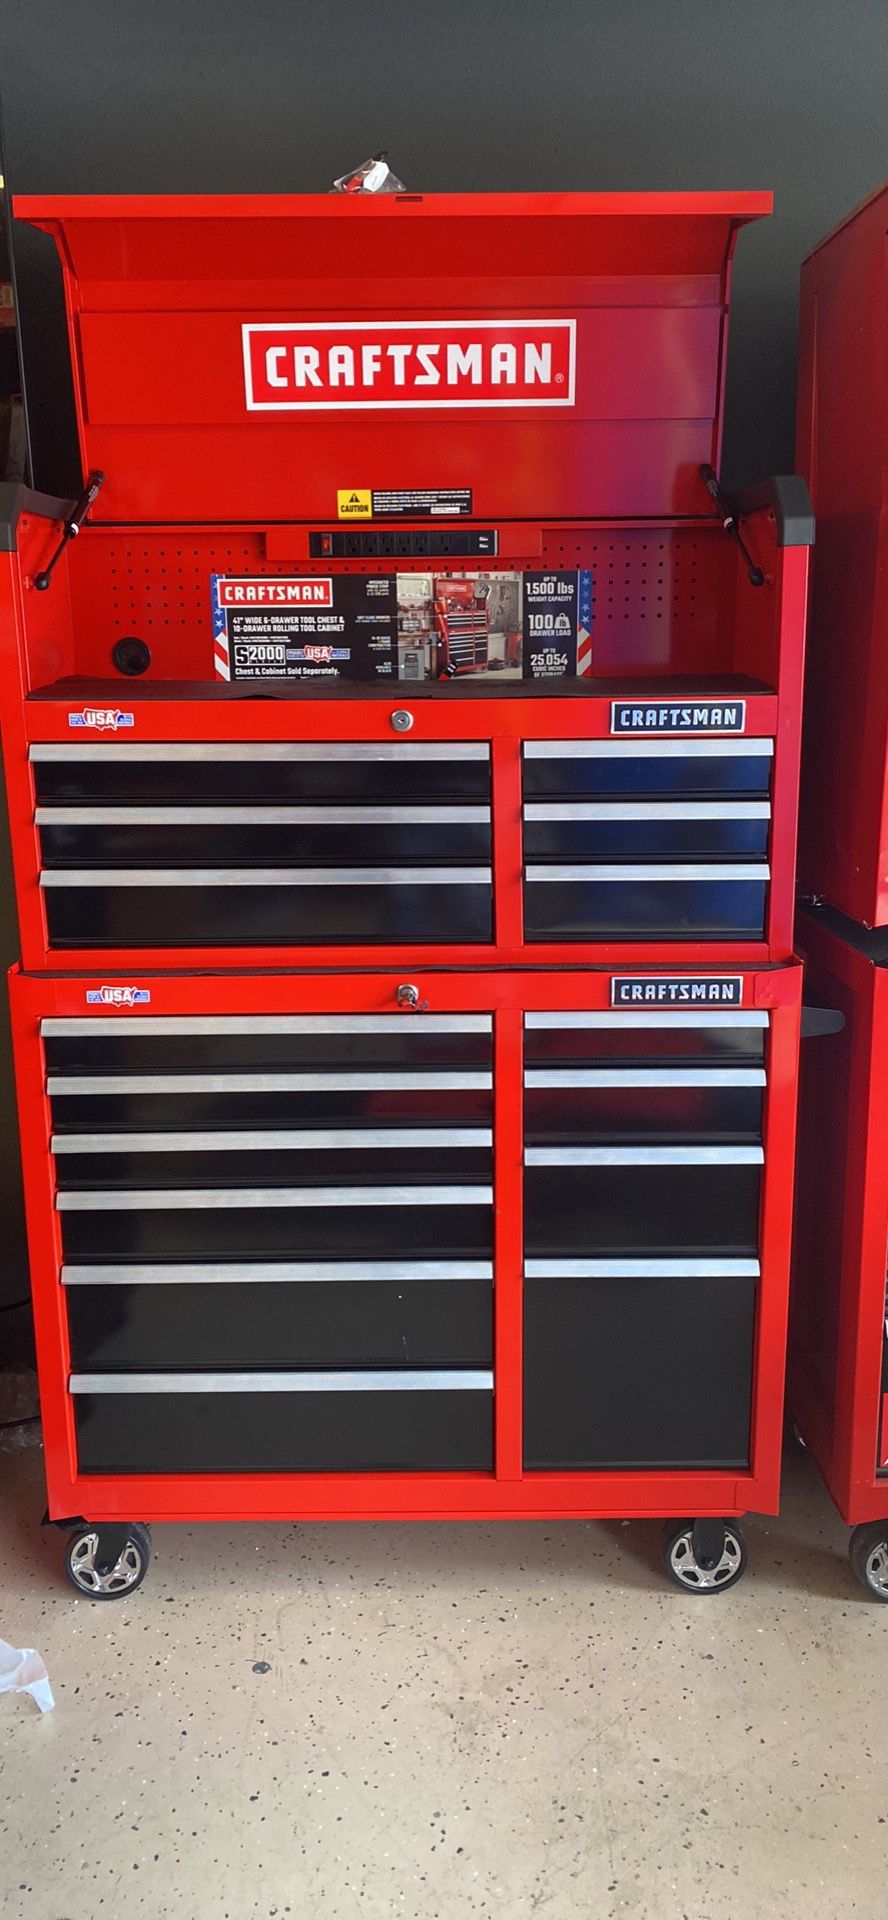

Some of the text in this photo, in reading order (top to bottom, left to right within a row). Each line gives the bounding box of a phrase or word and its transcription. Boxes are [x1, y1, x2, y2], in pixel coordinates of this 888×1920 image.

[340, 504, 369, 513] CAUTION
[557, 582, 574, 594] lbs
[244, 616, 263, 624] WIDE
[300, 616, 316, 624] TOOL
[317, 616, 337, 624] CHEST
[338, 616, 345, 624] &
[528, 614, 554, 629] 100
[233, 624, 344, 632] 10-DRAWER ROLLING TOOL CABINET
[306, 649, 328, 658] USA
[261, 667, 286, 675] Cabinet
[287, 667, 302, 675] Sold
[86, 712, 115, 725] USA
[620, 708, 737, 726] CRAFTSMAN
[104, 989, 132, 1002] USA
[620, 984, 734, 1000] CRAFTSMAN
